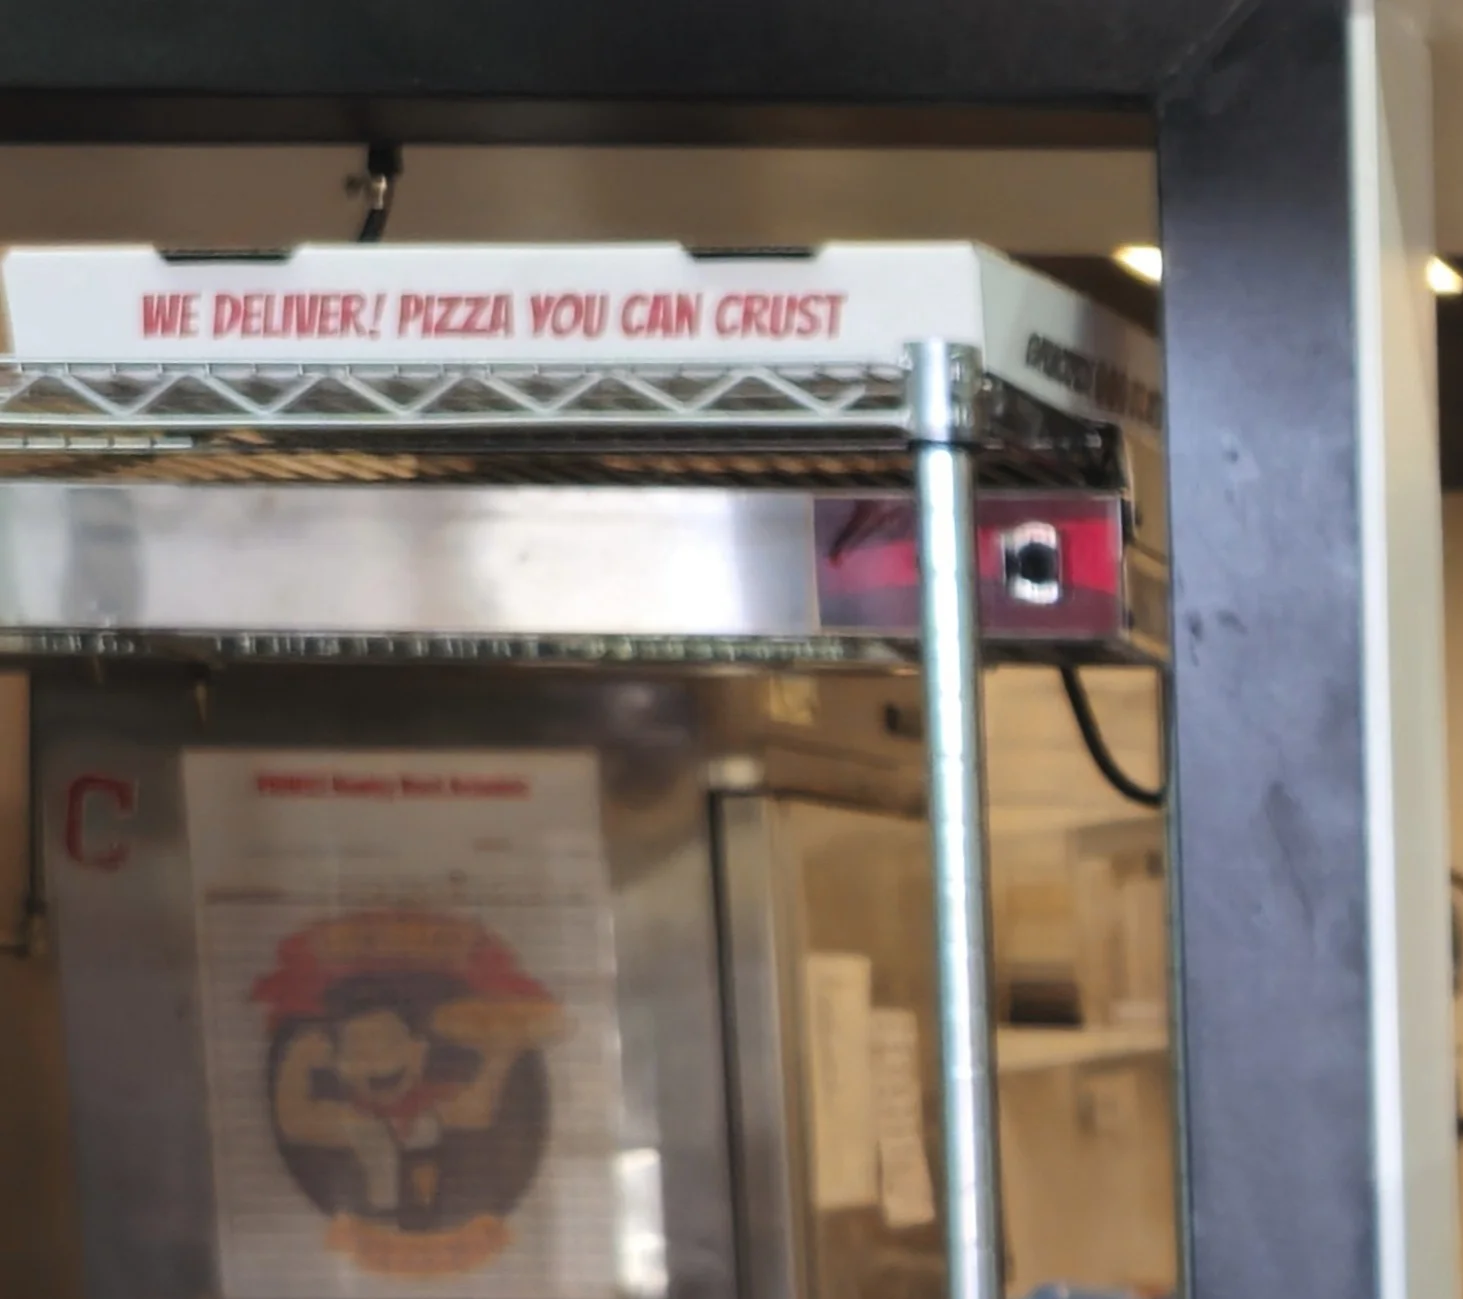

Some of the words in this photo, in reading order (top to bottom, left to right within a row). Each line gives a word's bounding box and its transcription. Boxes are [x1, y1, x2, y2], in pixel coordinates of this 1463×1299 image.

[142, 291, 200, 340] WE
[212, 291, 388, 341] DELIVER!
[397, 291, 514, 340] PIZZA
[529, 292, 609, 339] YOU
[619, 291, 703, 339] CAN
[714, 291, 849, 339] CRUST
